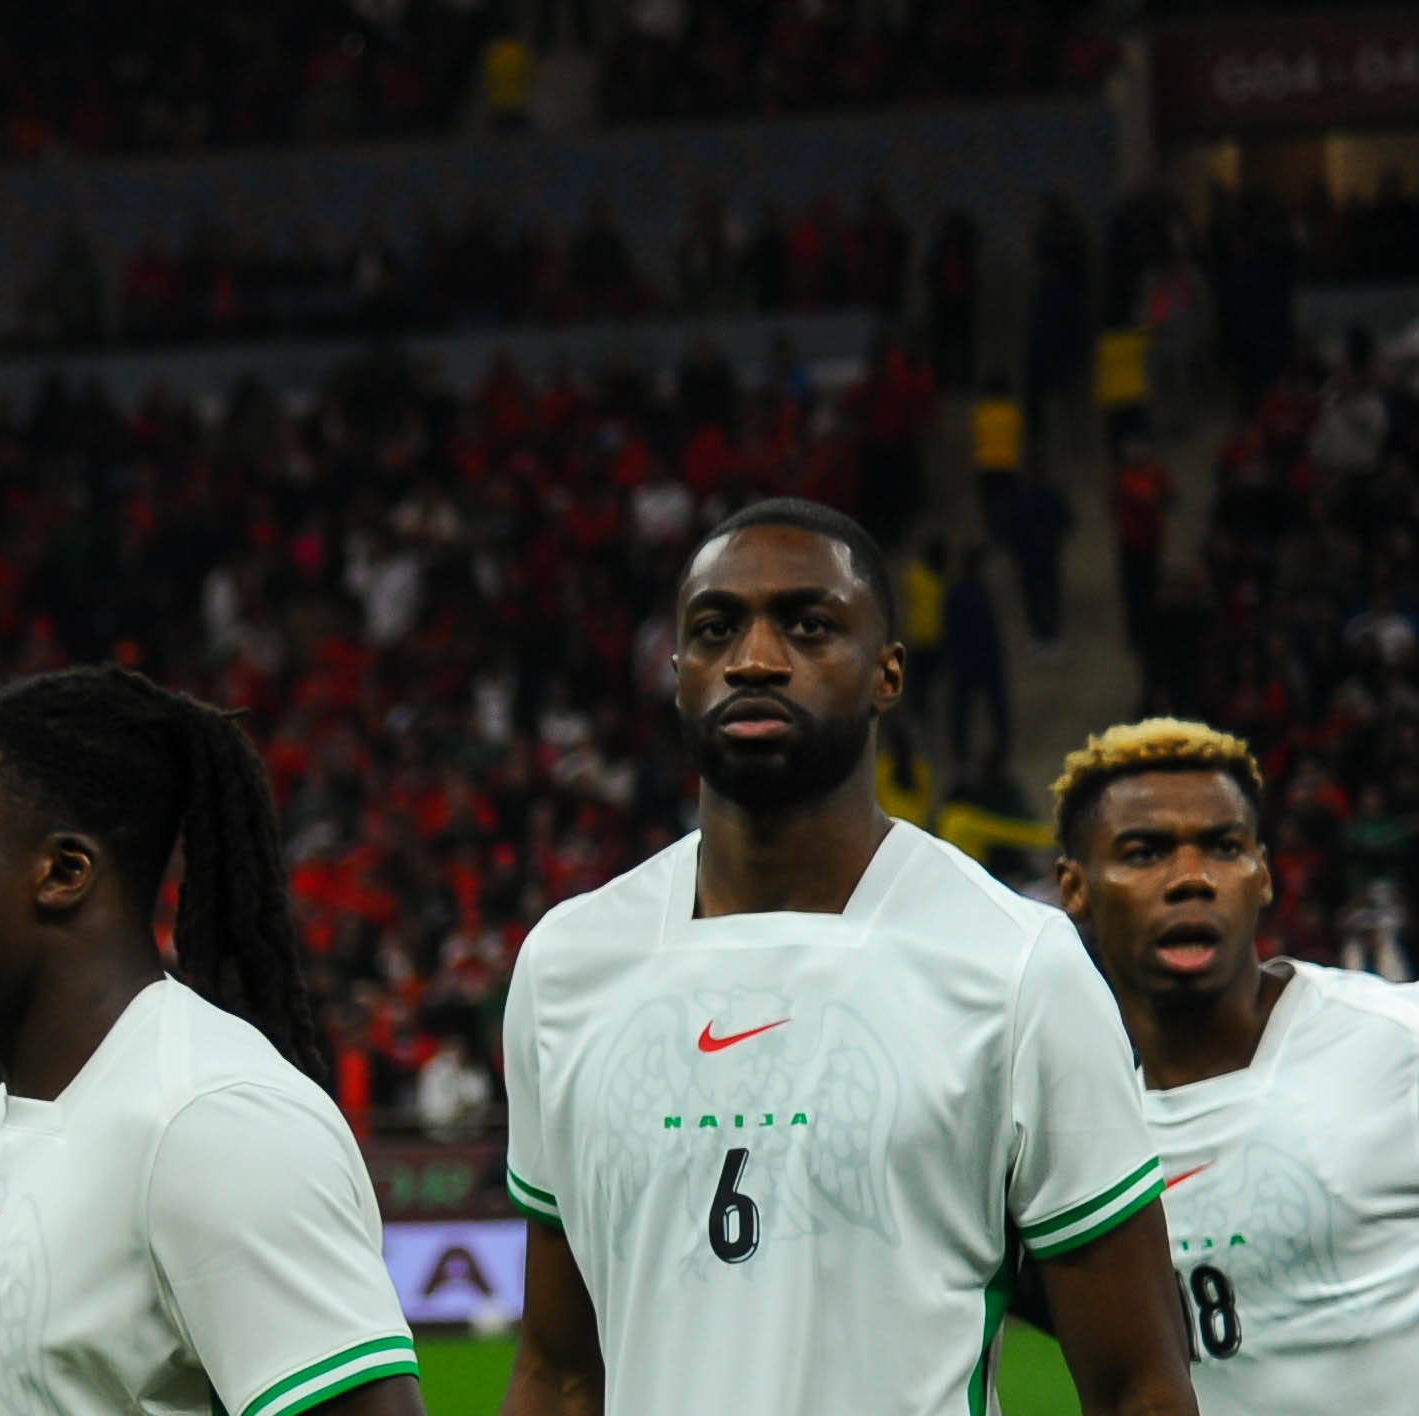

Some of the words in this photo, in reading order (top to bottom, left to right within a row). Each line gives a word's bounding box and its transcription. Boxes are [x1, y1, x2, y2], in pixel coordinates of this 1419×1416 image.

[663, 1112, 809, 1129] NAIJA
[708, 1147, 760, 1265] 6
[1179, 1234, 1246, 1252] IJA
